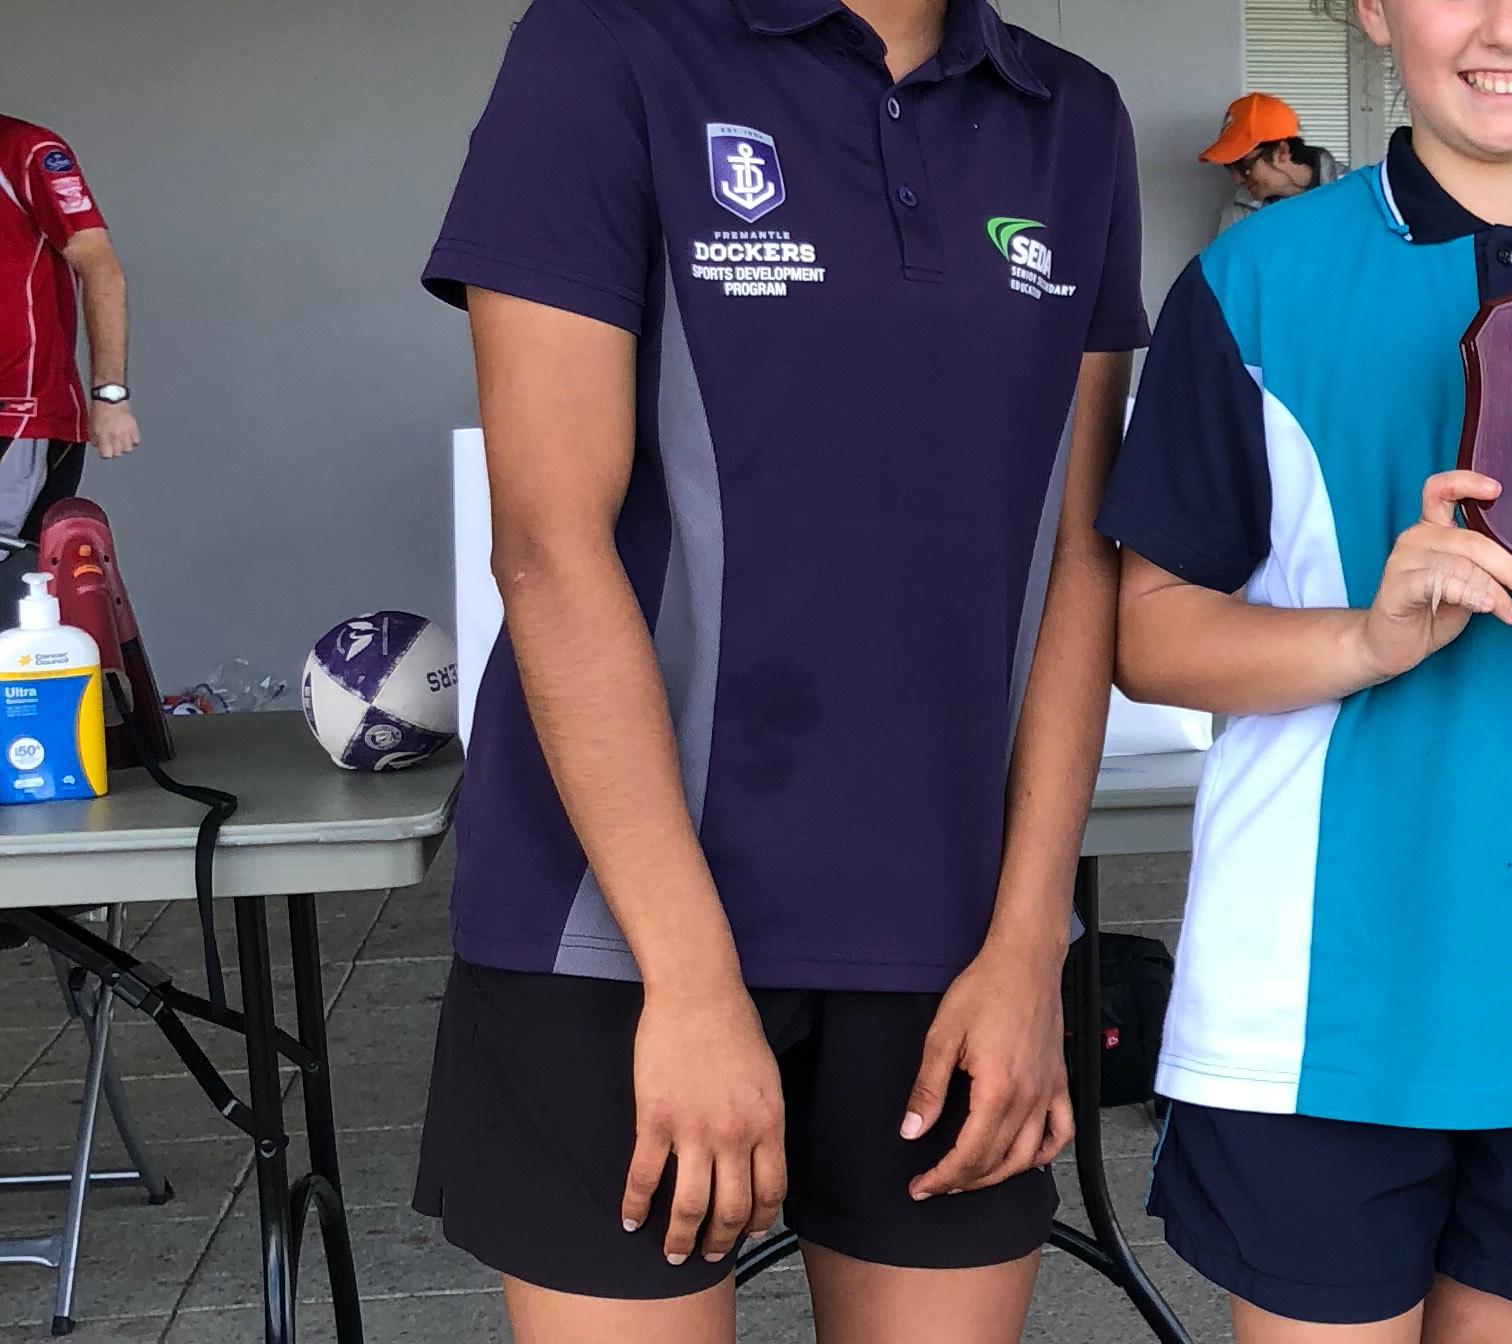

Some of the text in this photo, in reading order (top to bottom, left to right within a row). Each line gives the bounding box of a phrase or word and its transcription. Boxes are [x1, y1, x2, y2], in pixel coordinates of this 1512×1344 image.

[714, 231, 791, 240] FREMANTLE
[694, 241, 816, 263] DOCKERS
[1010, 235, 1052, 279] SEDA
[692, 264, 826, 282] SPORTS DEVELOPMENT
[724, 282, 787, 296] PROGRAM
[5, 687, 37, 698] Ultra
